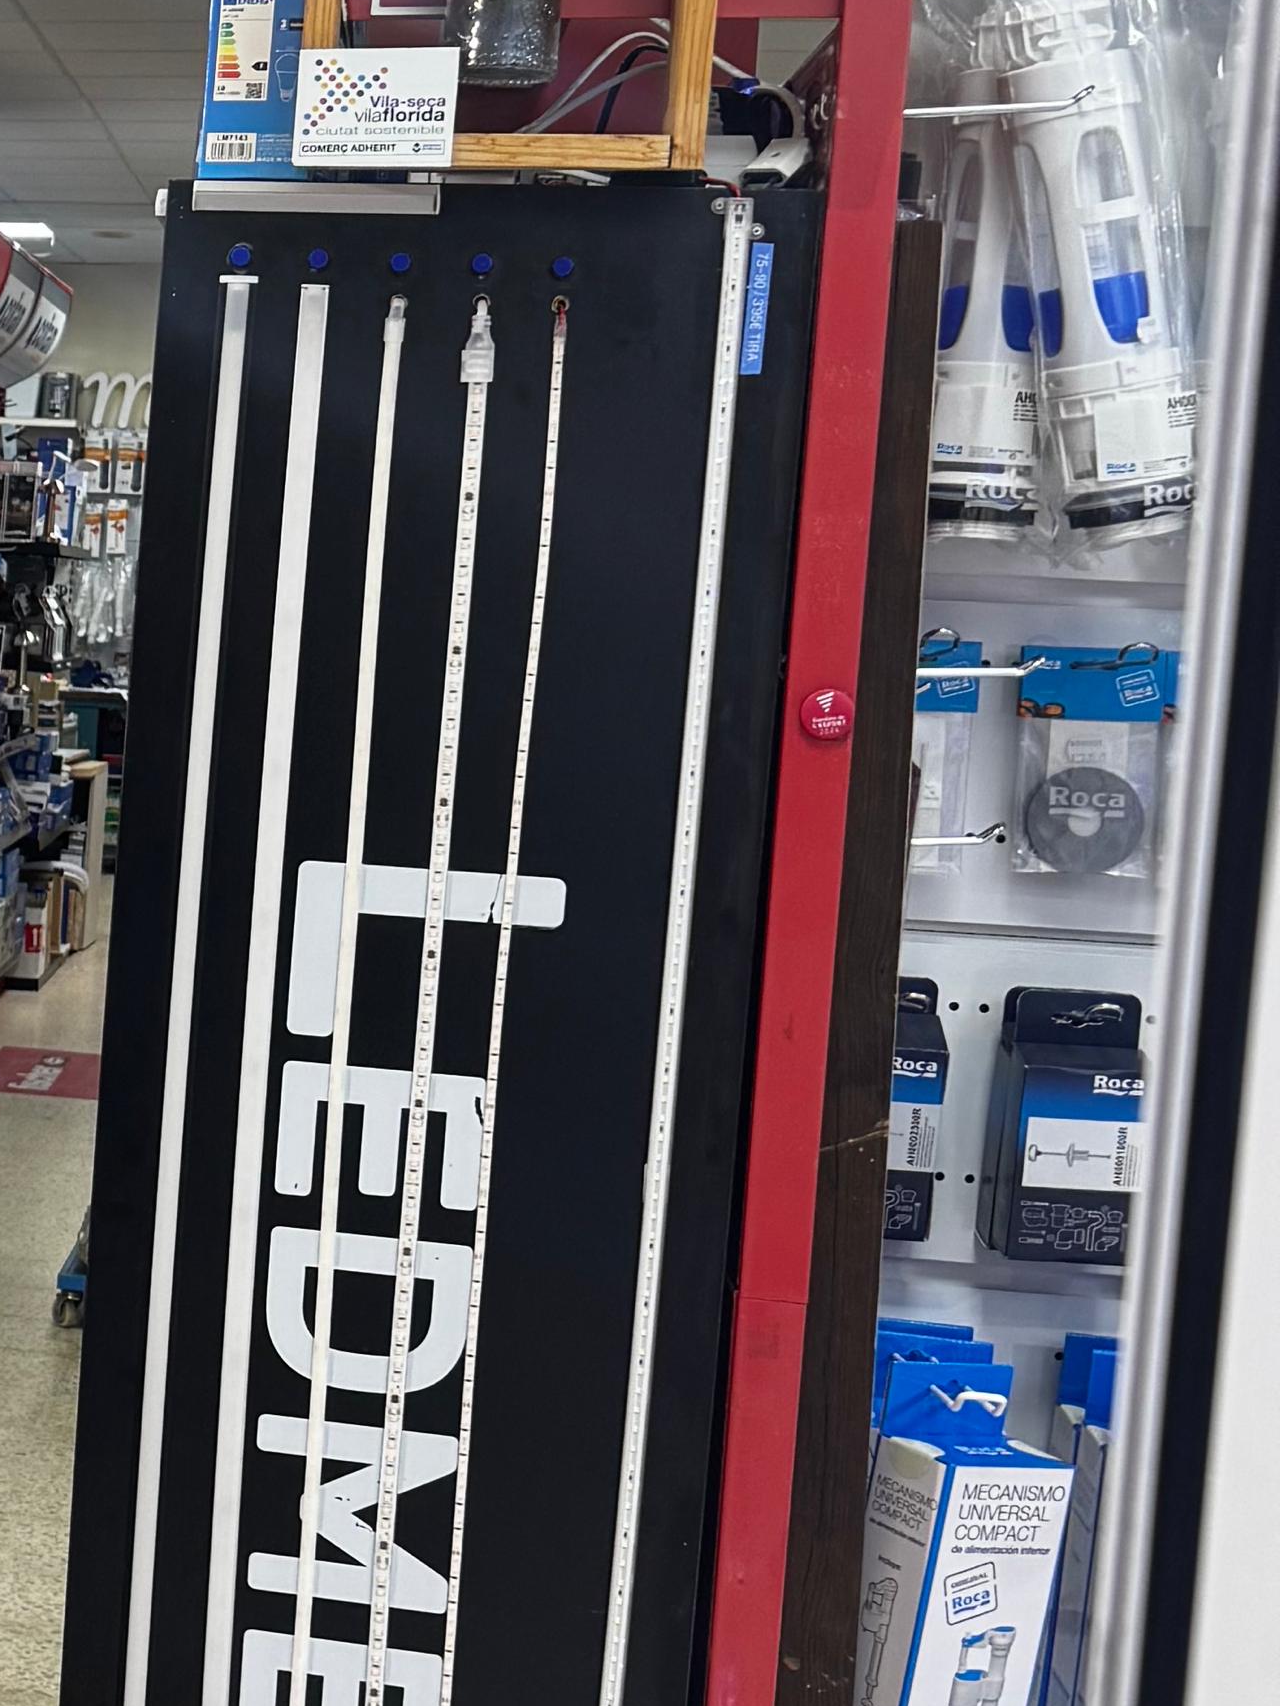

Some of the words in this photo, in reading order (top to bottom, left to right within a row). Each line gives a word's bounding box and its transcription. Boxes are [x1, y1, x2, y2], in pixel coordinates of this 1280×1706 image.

[370, 96, 446, 109] Vila-seca
[354, 107, 445, 123] vilaflorida
[315, 127, 359, 136] ciutat
[364, 125, 445, 136] sostenible
[301, 144, 348, 155] COMERÇ
[350, 143, 396, 153] ADHERIT
[1048, 785, 1126, 809] Roca
[892, 1056, 938, 1073] Roca
[1093, 1075, 1145, 1089] Roca
[962, 1483, 1066, 1502] MECANISMO
[872, 1500, 922, 1532] COMPACT
[959, 1504, 1051, 1522] UNIVERSAL
[954, 1524, 1040, 1542] COMPACT
[951, 1545, 963, 1554] de
[952, 1588, 991, 1609] Roca
